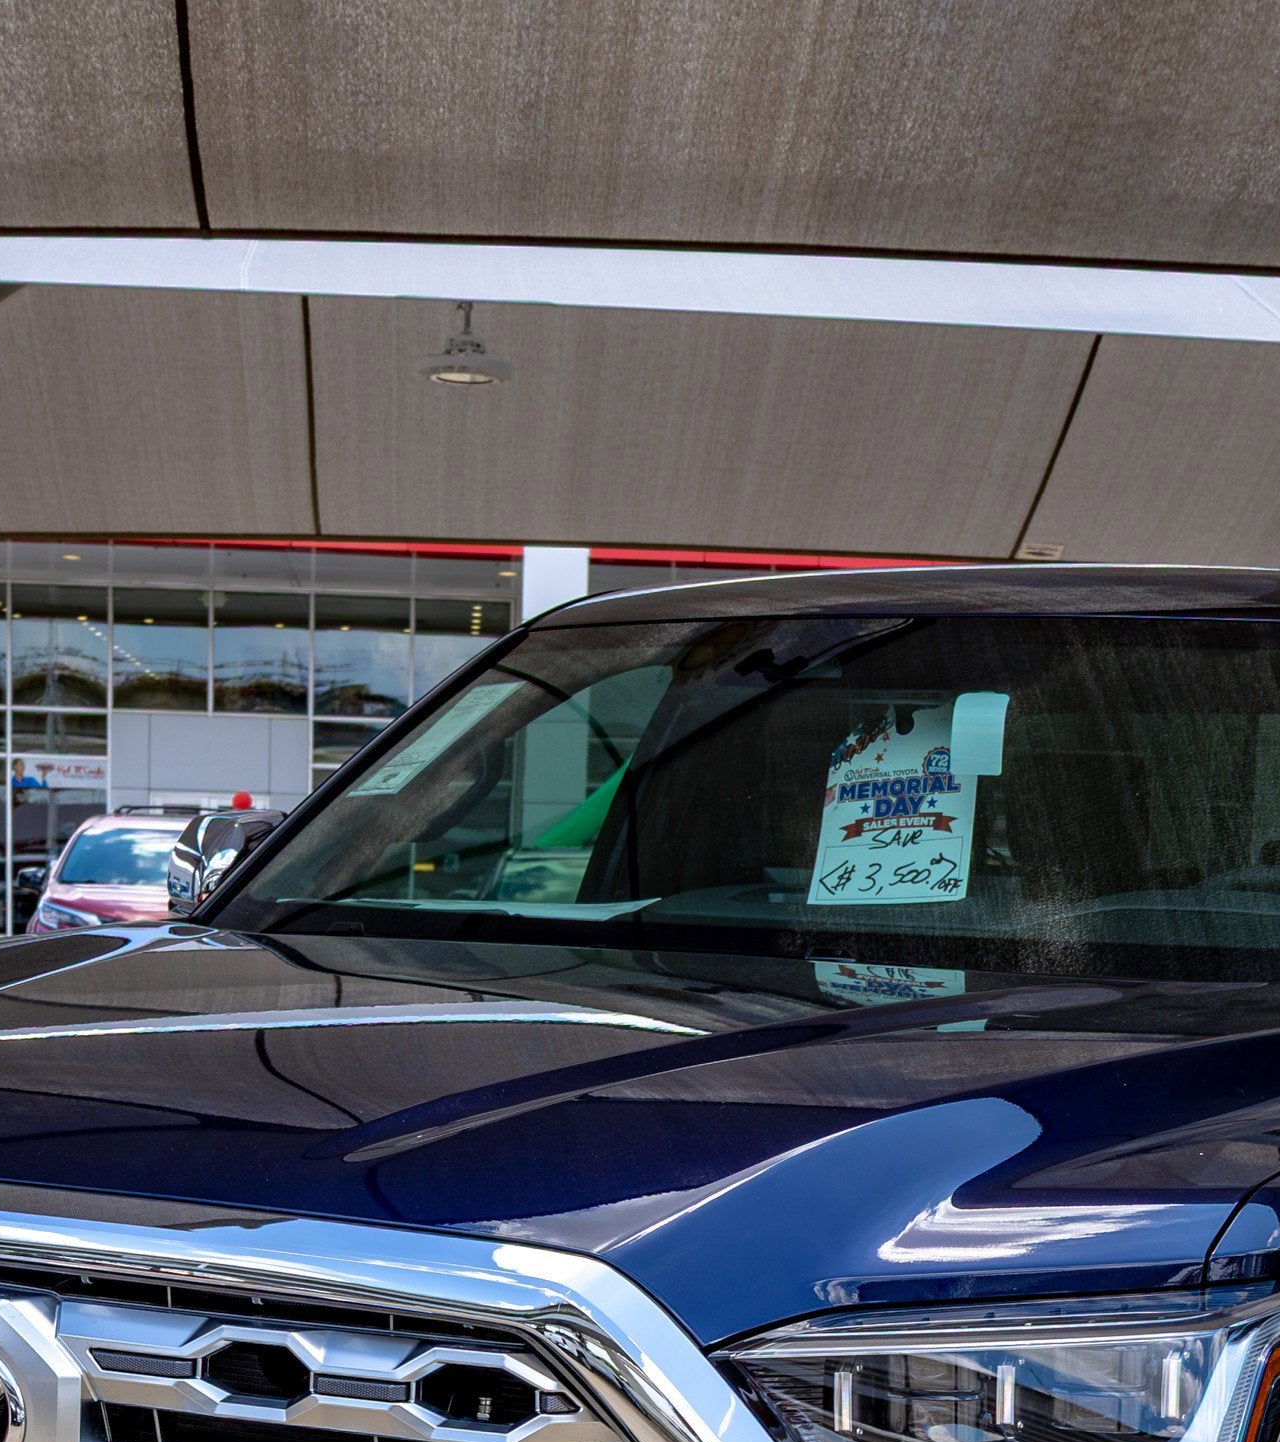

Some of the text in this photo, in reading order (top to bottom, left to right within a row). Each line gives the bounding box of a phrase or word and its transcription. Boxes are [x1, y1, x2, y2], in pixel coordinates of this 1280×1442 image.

[931, 754, 949, 767] 72
[855, 768, 919, 781] UNIVERSAL TOYOTA
[838, 773, 961, 803] MEMORIAL
[874, 795, 927, 819] DAY
[863, 816, 936, 831] SALES EVENT
